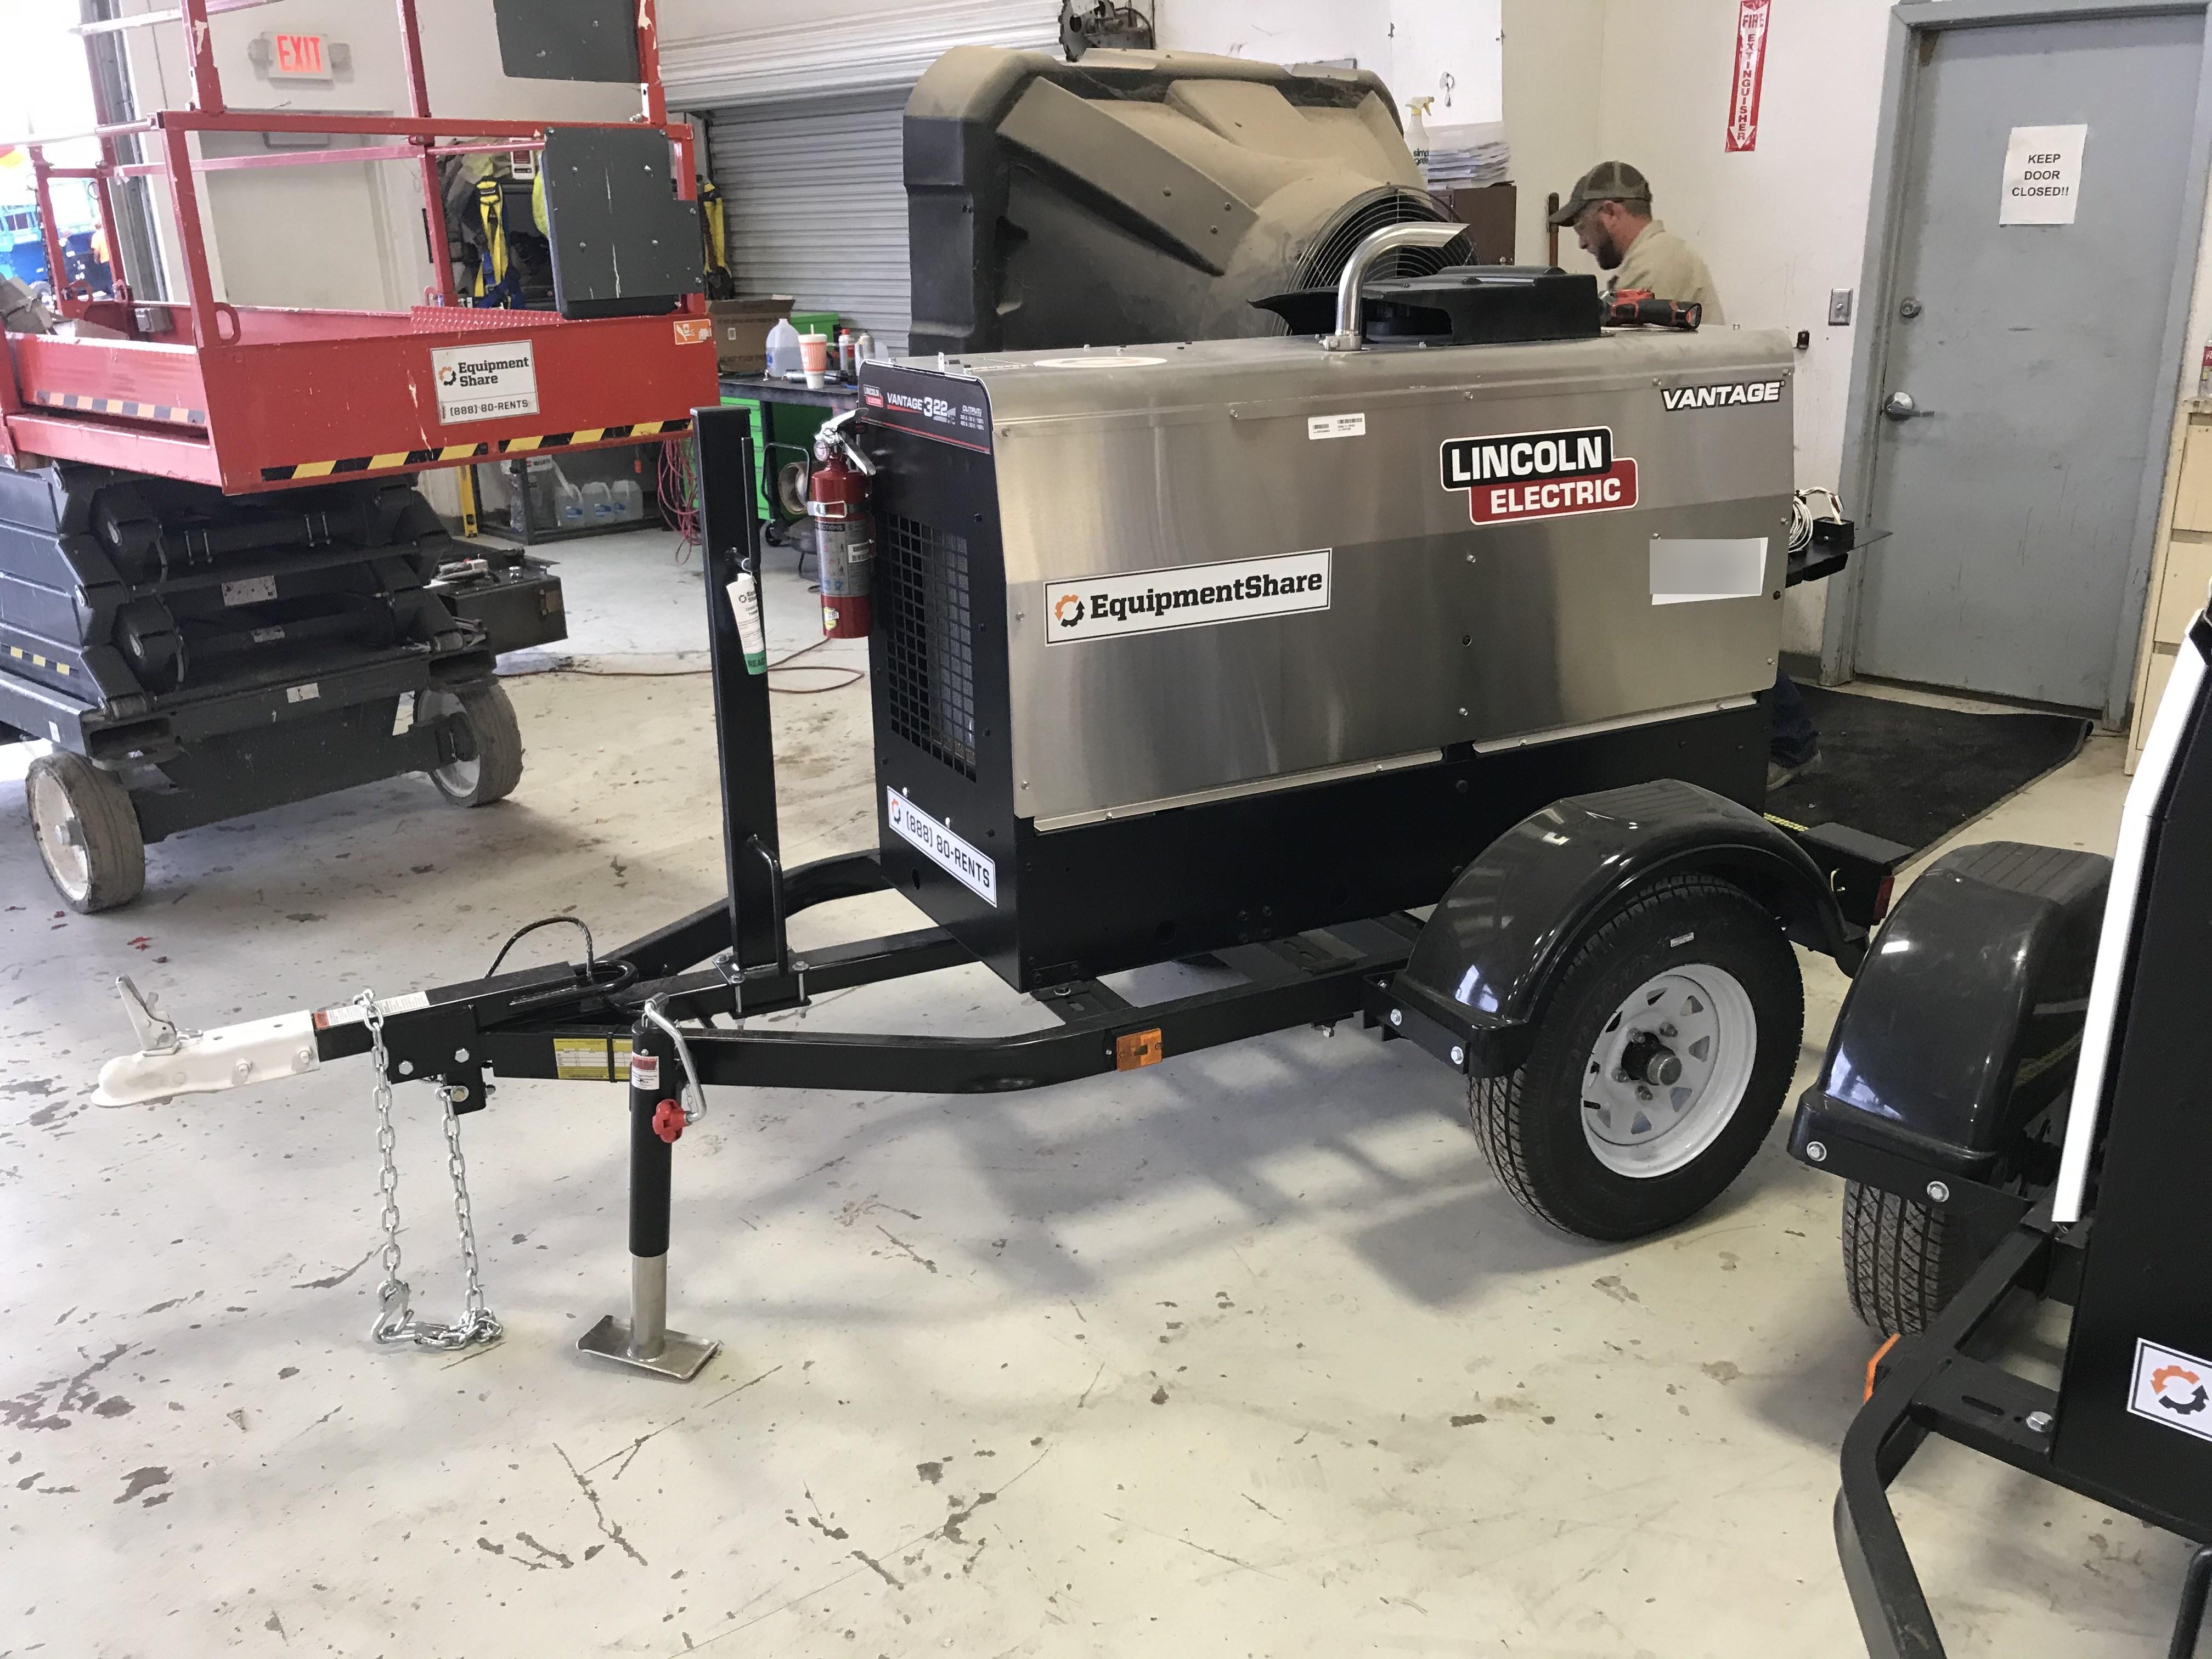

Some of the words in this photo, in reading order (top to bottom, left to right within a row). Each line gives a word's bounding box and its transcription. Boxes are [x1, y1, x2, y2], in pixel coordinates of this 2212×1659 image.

[1742, 13, 1764, 28] FIRE
[276, 35, 322, 72] EXIT
[1737, 33, 1755, 140] EXTINGUISHER
[2028, 154, 2061, 163] KEEP
[2024, 171, 2060, 180] DOOR
[2012, 187, 2069, 196] CLOSED!!
[458, 357, 529, 375] Equipment
[460, 375, 498, 387] Share
[450, 404, 478, 416] (888)
[481, 399, 528, 412] 80-RENTS
[887, 392, 922, 410] VANTAGE
[924, 397, 947, 417] 322
[1663, 382, 1780, 410] VANTAGE
[1452, 436, 1602, 481] LINCOLN
[1491, 478, 1621, 514] ELECTRIC
[1090, 573, 1322, 621] EquipmentShare
[906, 811, 933, 848] (888)
[936, 834, 990, 888] 80-RENTS
